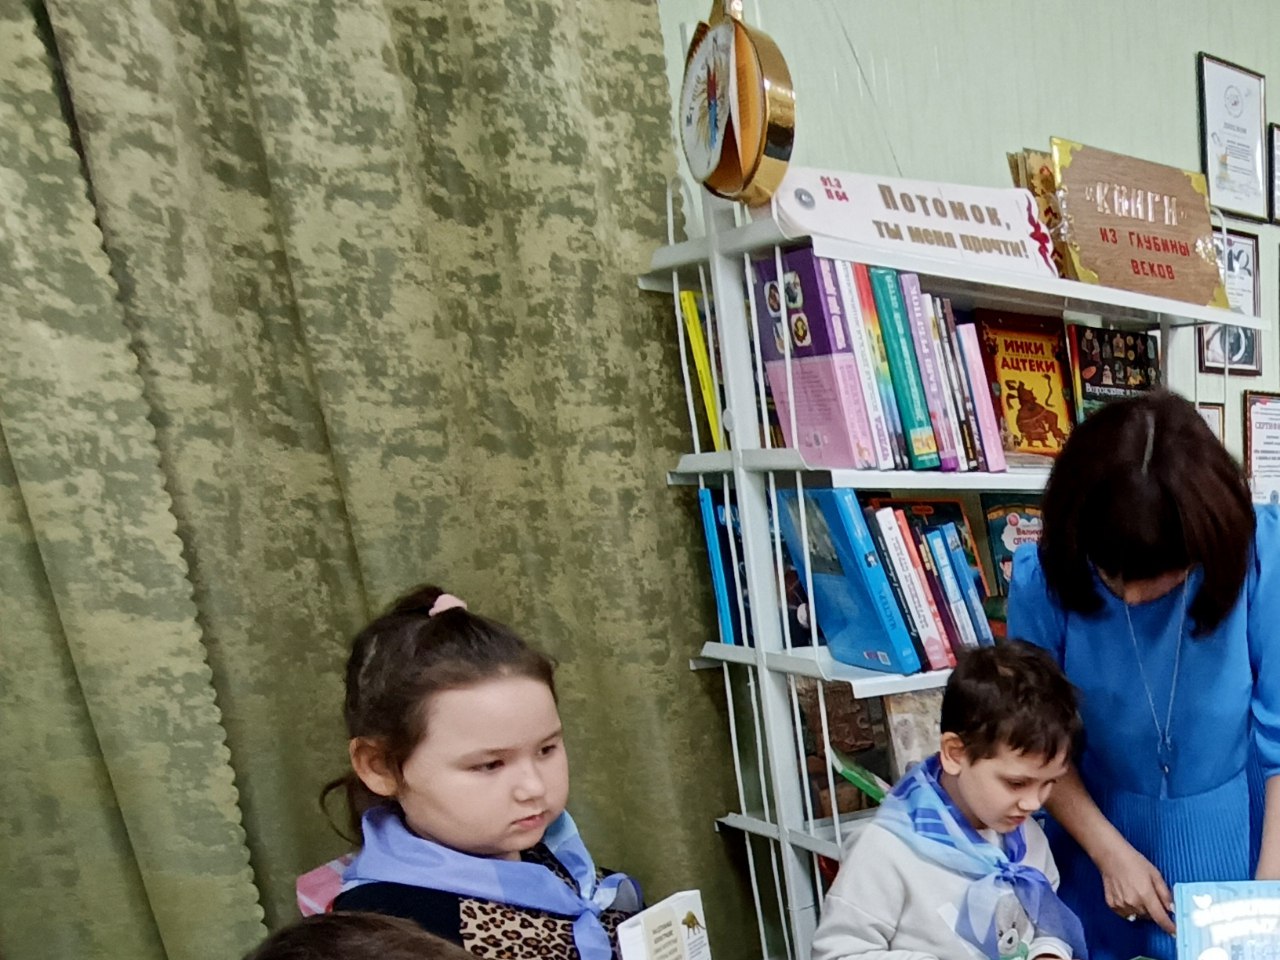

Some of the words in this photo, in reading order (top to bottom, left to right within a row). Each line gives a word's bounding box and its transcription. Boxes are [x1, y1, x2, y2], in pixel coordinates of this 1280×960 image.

[820, 175, 841, 189] 91.3
[877, 183, 1012, 231] Потомок,
[872, 219, 904, 241] ты
[907, 225, 957, 249] меня
[959, 233, 1031, 258] прочти!
[1100, 227, 1118, 244] ИЗ
[1128, 231, 1191, 257] ГЛУБИНЫ
[1131, 259, 1175, 280] ВЕКОВ
[1004, 339, 1045, 355] ИНКИ
[1000, 357, 1056, 374] АЦТЕКИ
